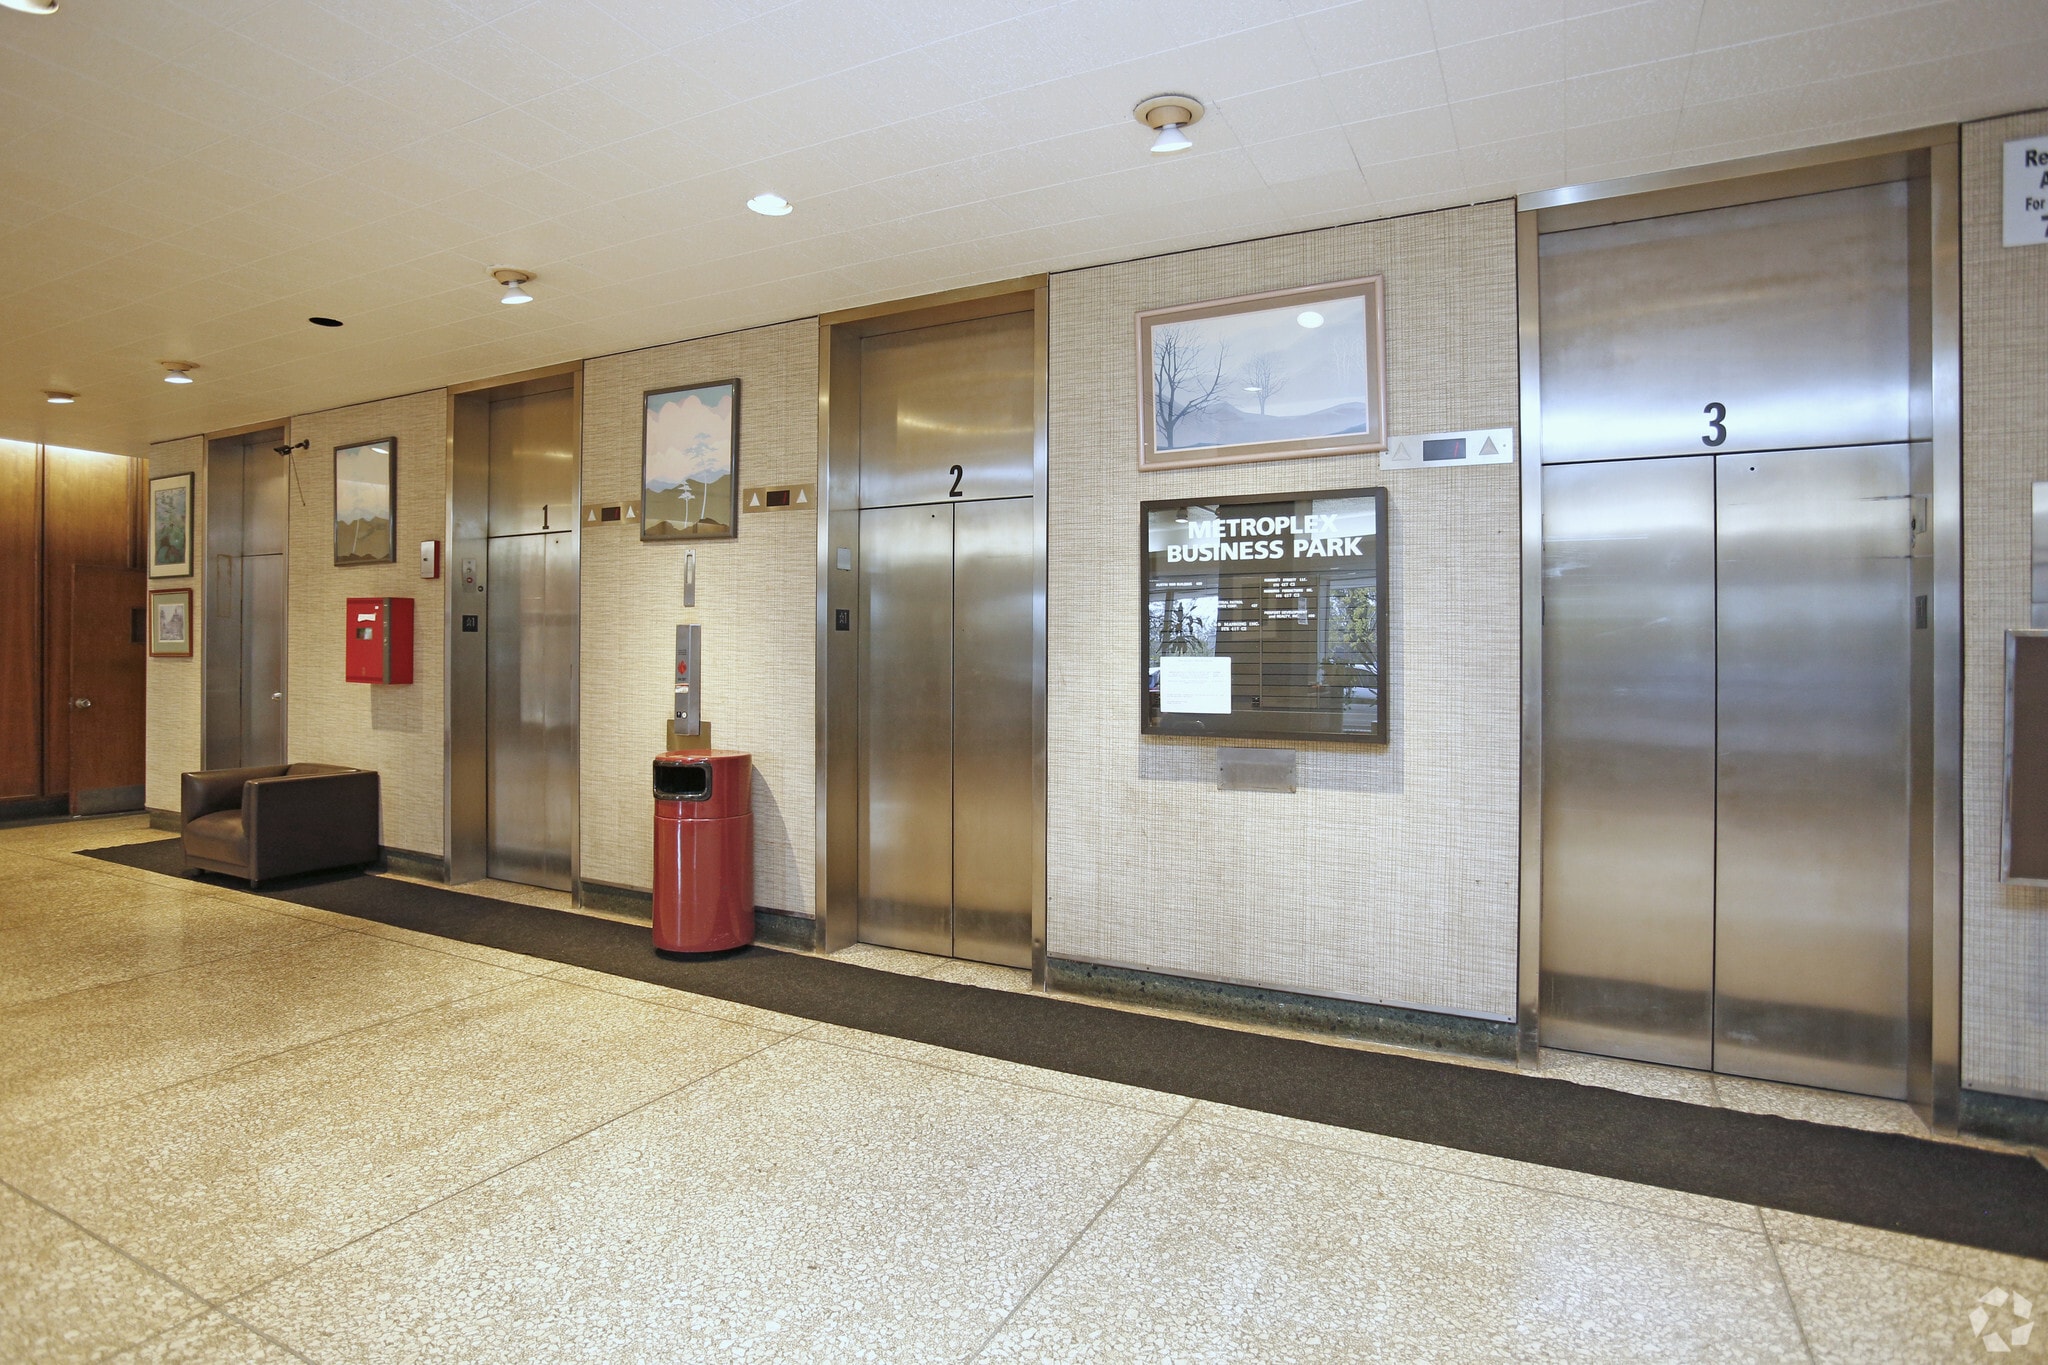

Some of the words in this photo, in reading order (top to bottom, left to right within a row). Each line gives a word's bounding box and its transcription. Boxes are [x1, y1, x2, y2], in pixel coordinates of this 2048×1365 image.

[2025, 197, 2046, 211] For
[1701, 402, 1727, 447] 3
[949, 464, 963, 497] 2
[542, 504, 549, 530] 1
[1188, 514, 1338, 539] METROPLEX
[1167, 540, 1284, 563] BUSINESS
[1293, 537, 1364, 558] PARK
